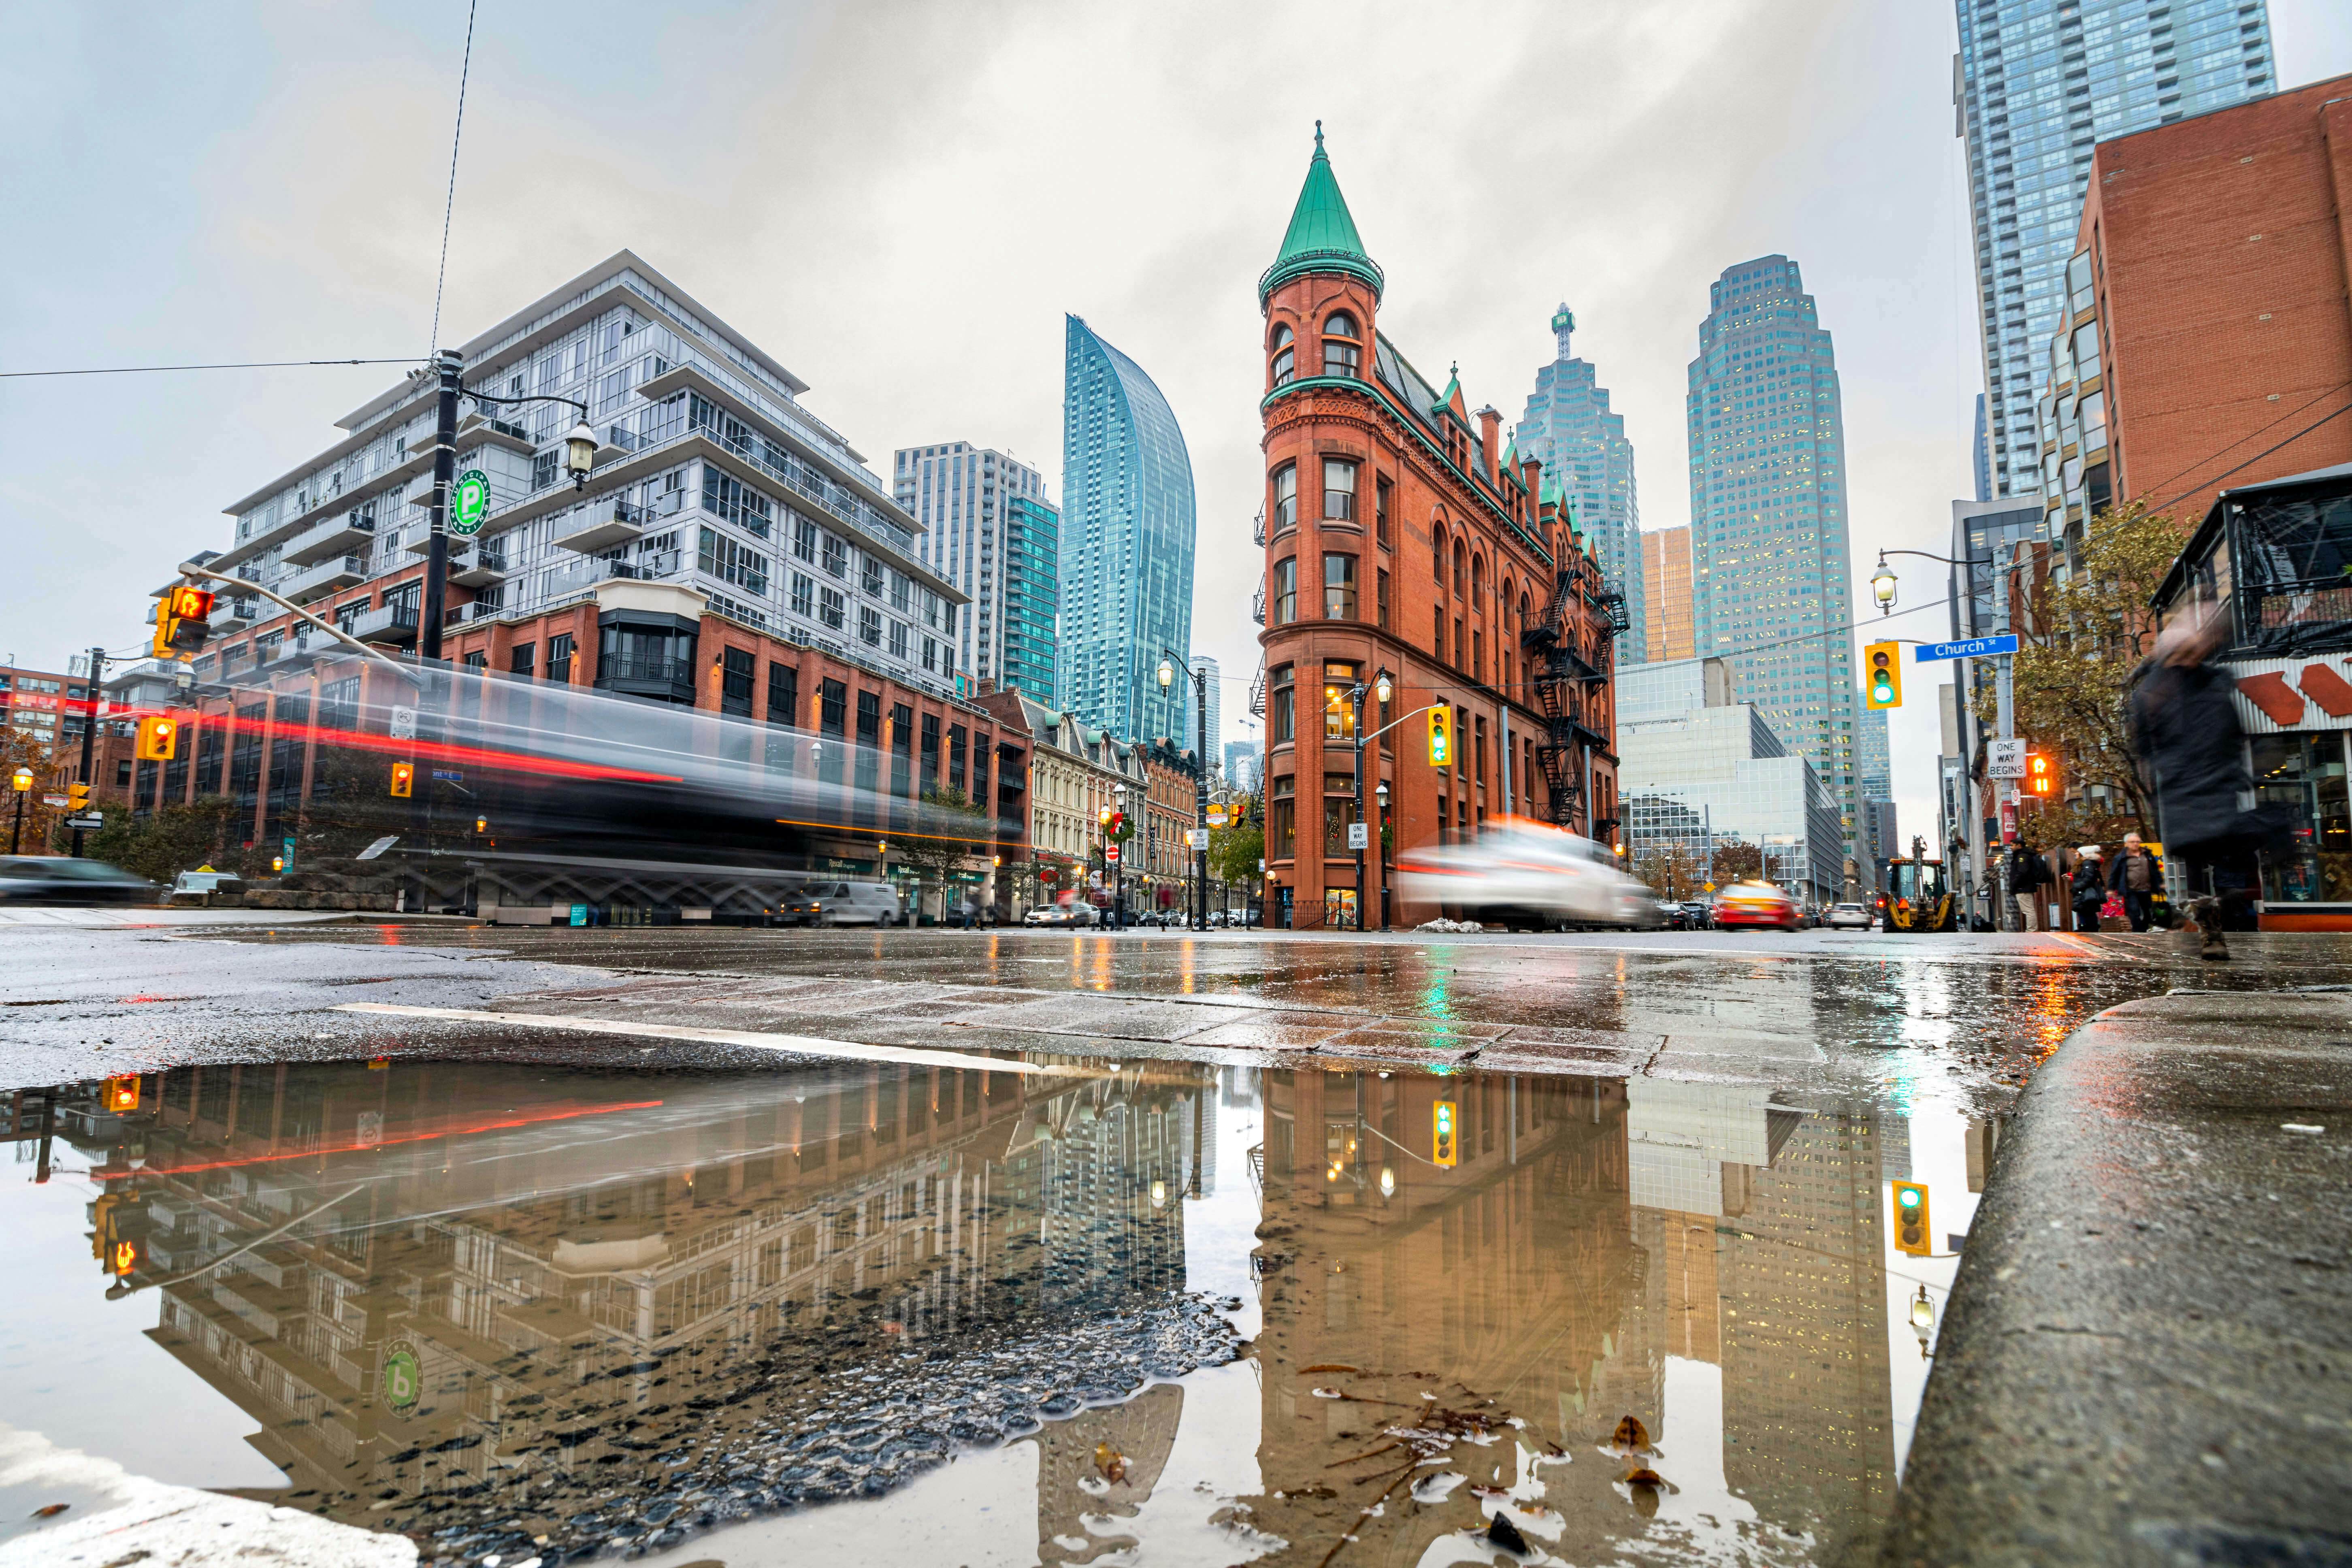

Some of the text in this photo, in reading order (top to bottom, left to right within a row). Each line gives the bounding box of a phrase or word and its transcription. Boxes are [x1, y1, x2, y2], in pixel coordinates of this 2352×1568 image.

[1557, 315, 1566, 324] TD
[451, 472, 489, 504] MUNICIPAL
[461, 485, 480, 514] P
[450, 504, 489, 533] PARKING
[1935, 640, 1985, 656] Church
[1997, 743, 2015, 752] ONE
[1997, 754, 2015, 763] WAY
[1990, 765, 2023, 775] BEGINS
[829, 859, 843, 868] Rexall
